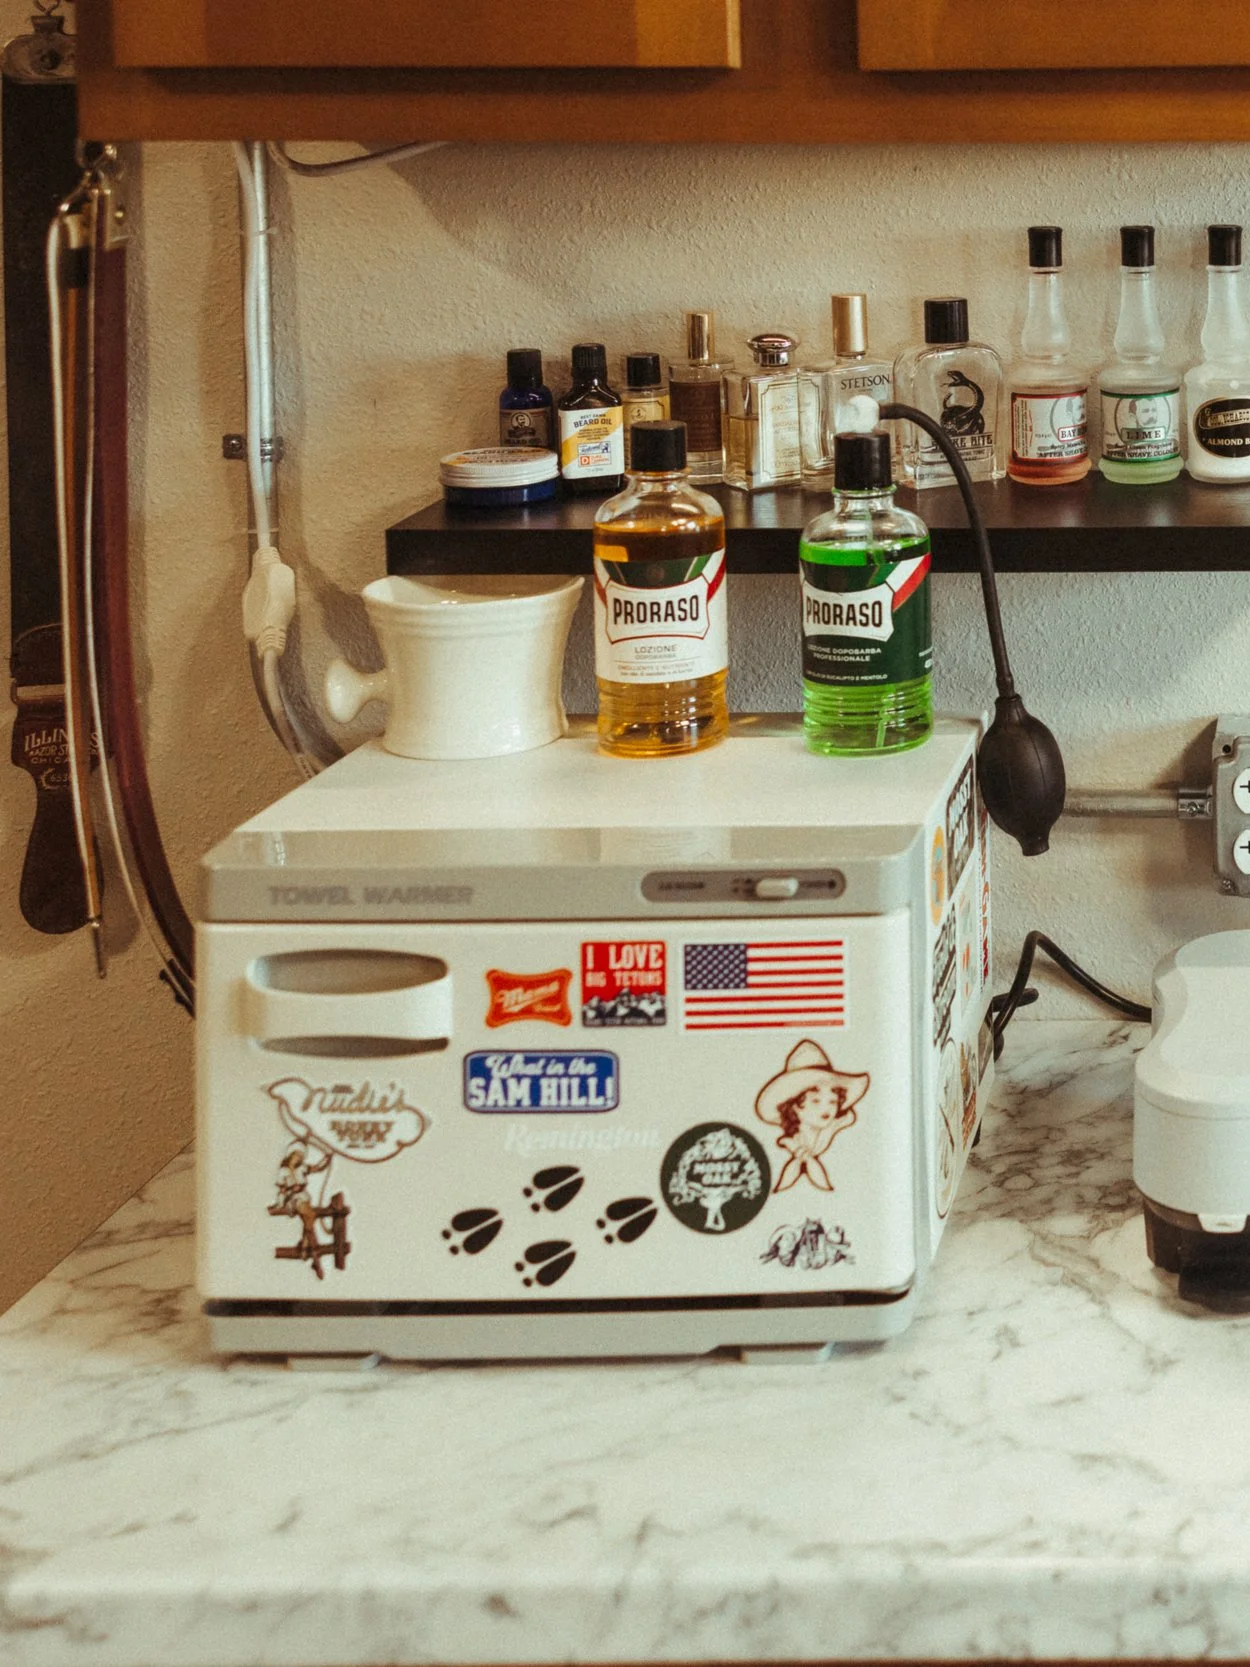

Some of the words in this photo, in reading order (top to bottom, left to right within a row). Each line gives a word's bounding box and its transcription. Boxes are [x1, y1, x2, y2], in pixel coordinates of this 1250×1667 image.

[840, 374, 890, 390] STETSON
[573, 419, 600, 428] BEARD
[1061, 429, 1077, 438] BAY
[1126, 431, 1161, 440] LIME
[970, 434, 993, 447] BITE
[1208, 438, 1243, 446] ALMOND
[613, 594, 699, 625] PRORASO
[806, 595, 883, 628] PRORASO
[634, 644, 677, 654] LOZIONE
[832, 647, 882, 655] DOPOBARBA
[813, 652, 871, 662] PROFESSIONALE
[268, 885, 354, 905] TOWEL
[363, 885, 475, 905] WARMER
[586, 945, 594, 969] I
[609, 943, 663, 970] LOVE
[585, 971, 607, 988] BIG
[614, 970, 663, 988] TETONS
[484, 1053, 545, 1078] What
[545, 1058, 566, 1076] in
[568, 1057, 597, 1076] the
[469, 1075, 531, 1107] SAM
[540, 1075, 615, 1107] HILL!
[503, 1123, 662, 1157] Remington
[693, 1161, 740, 1174] MOSSY
[702, 1173, 731, 1185] OAK
